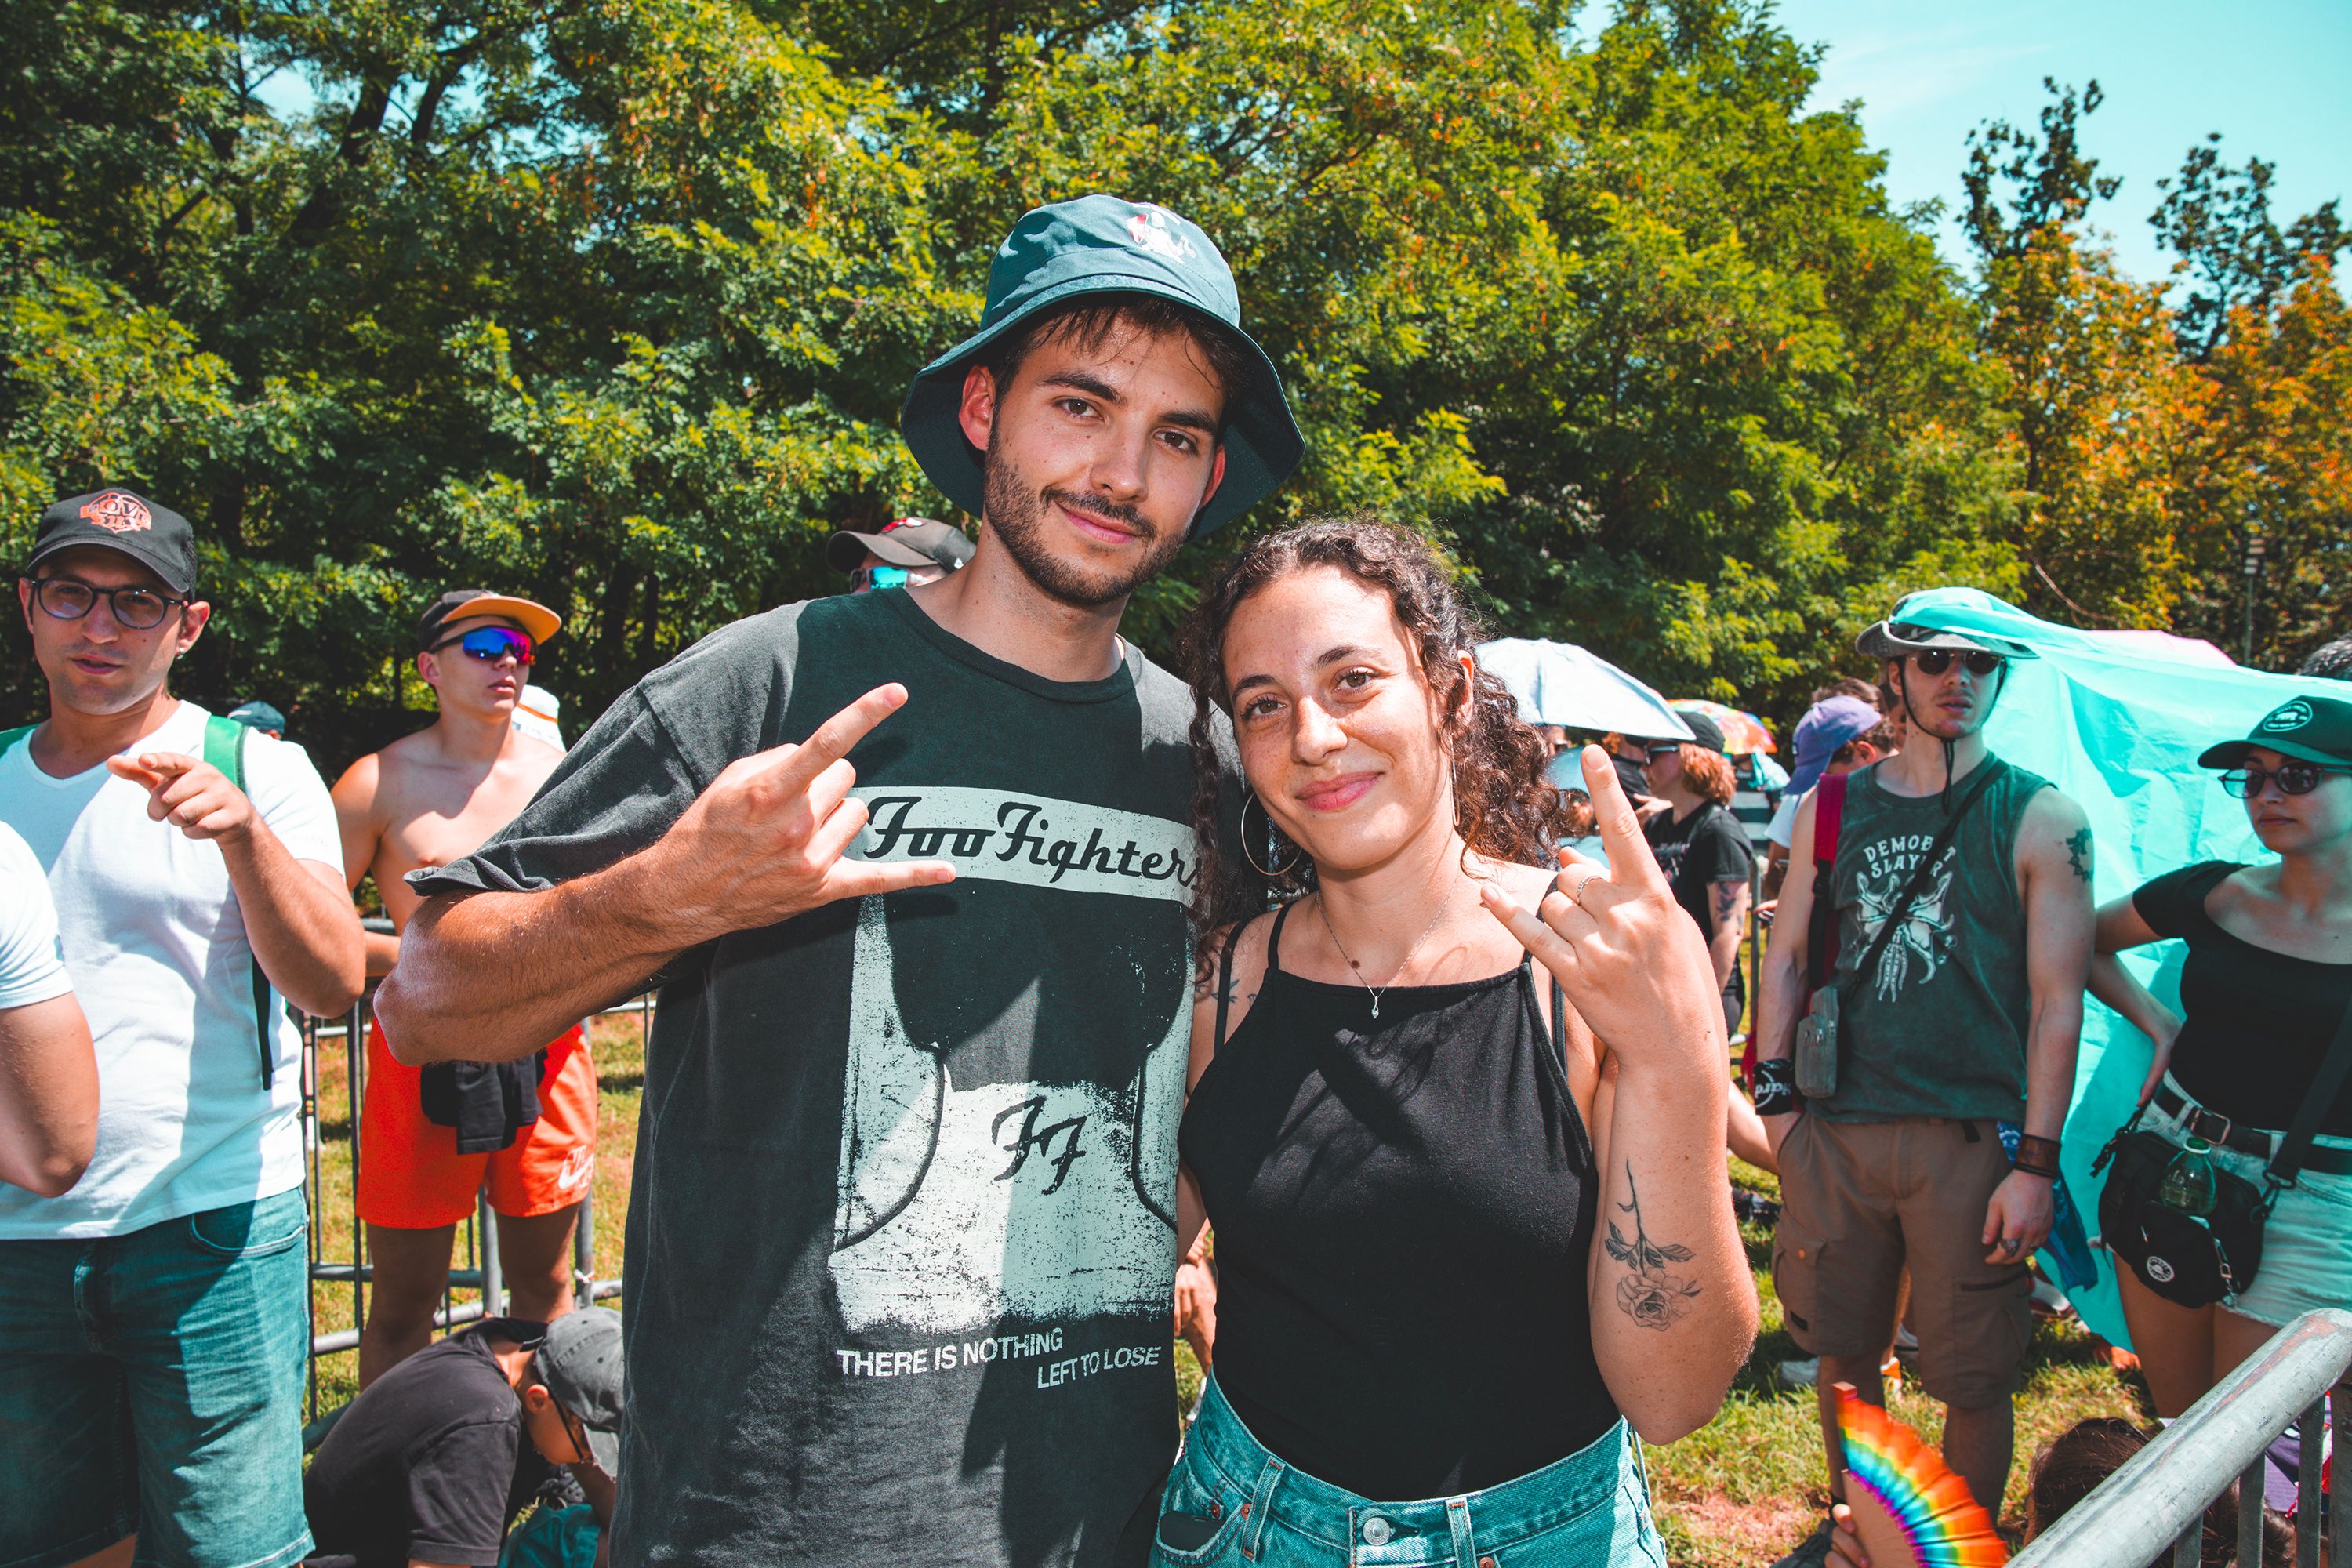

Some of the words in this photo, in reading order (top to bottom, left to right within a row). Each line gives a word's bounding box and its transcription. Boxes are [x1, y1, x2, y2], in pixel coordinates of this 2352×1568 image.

[863, 796, 996, 858] Foo
[1863, 834, 1957, 862] DEMOBT
[1871, 853, 1944, 878] SLAYR
[991, 1095, 1087, 1196] FF
[836, 1348, 929, 1377] THERE
[935, 1345, 957, 1370] IS
[963, 1327, 1063, 1366] NOTHING
[1037, 1357, 1078, 1389] LEFT
[1080, 1352, 1100, 1377] TO
[1103, 1346, 1162, 1370] LOSE
